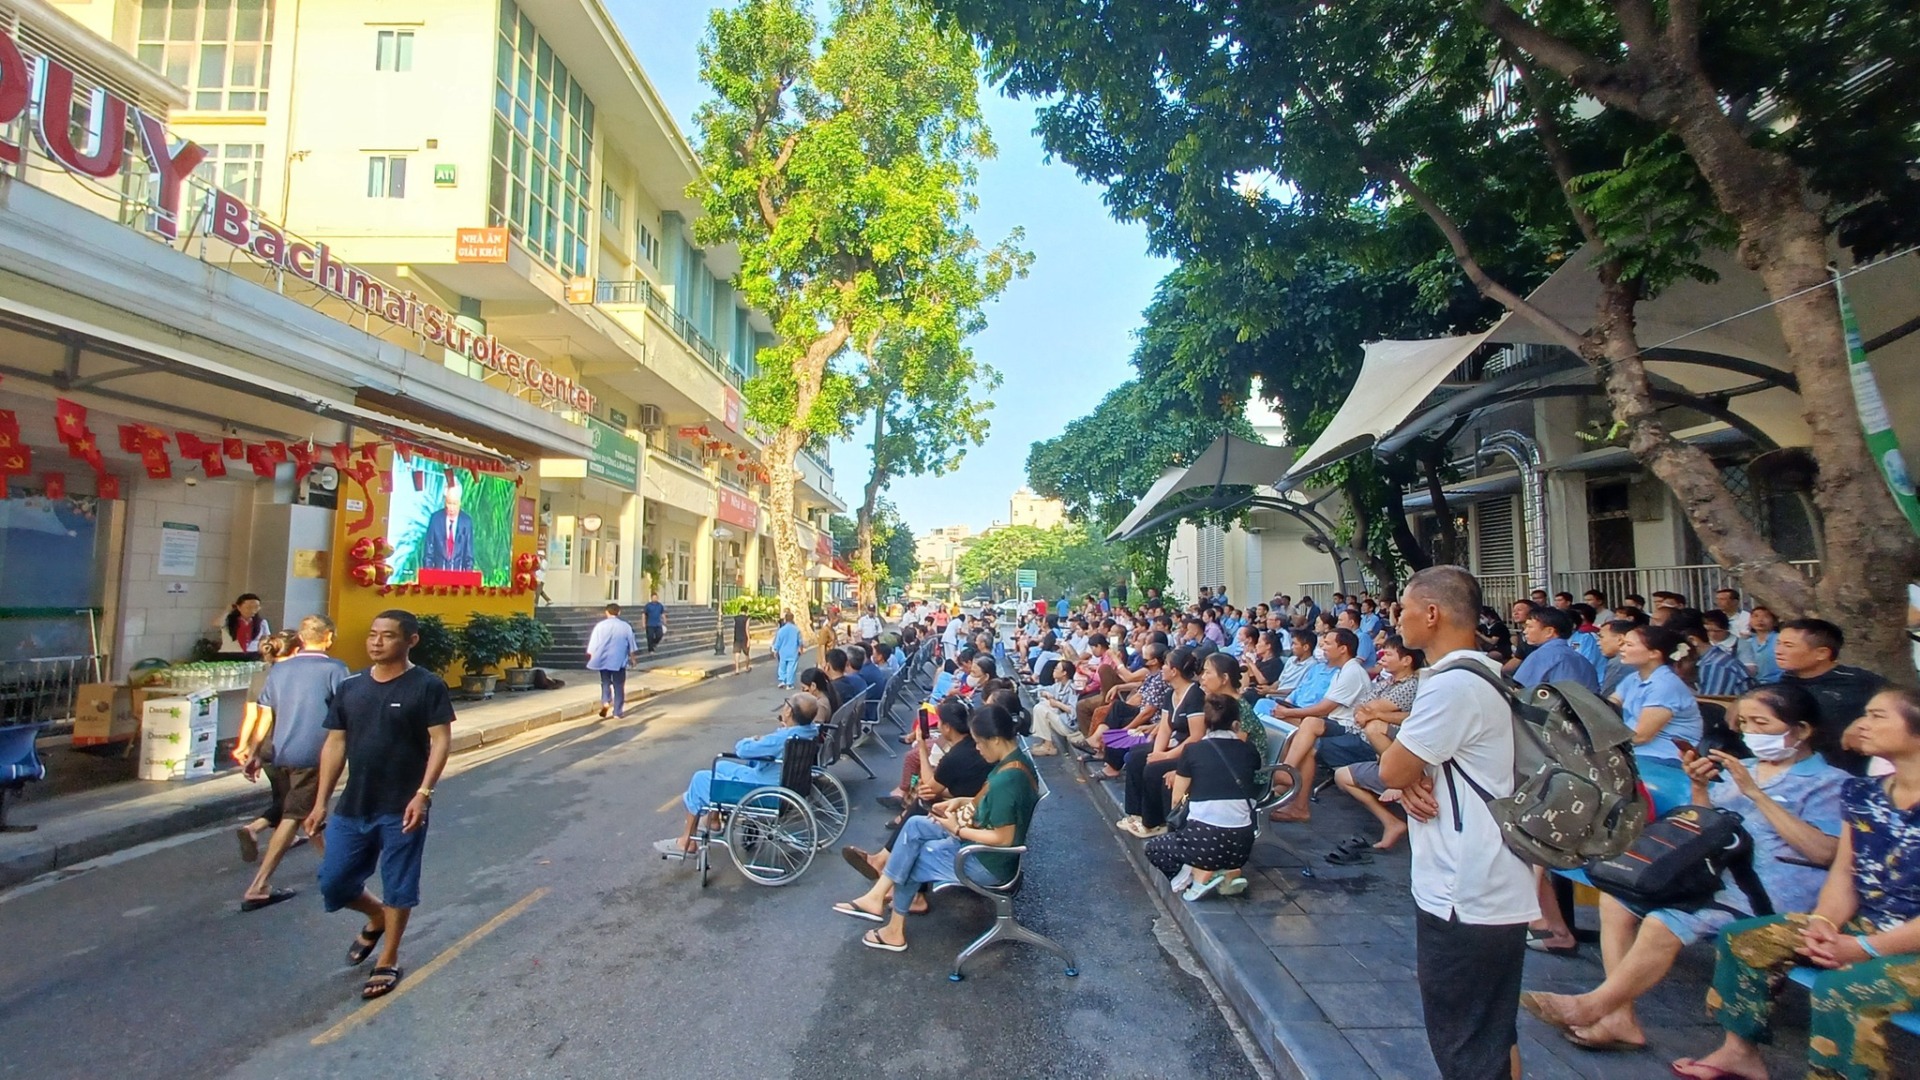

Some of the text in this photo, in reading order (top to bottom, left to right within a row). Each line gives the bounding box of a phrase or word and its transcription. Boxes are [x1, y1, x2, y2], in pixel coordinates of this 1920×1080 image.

[462, 231, 484, 244] NHÀ
[207, 187, 596, 413] Bachmai Stroke Center
